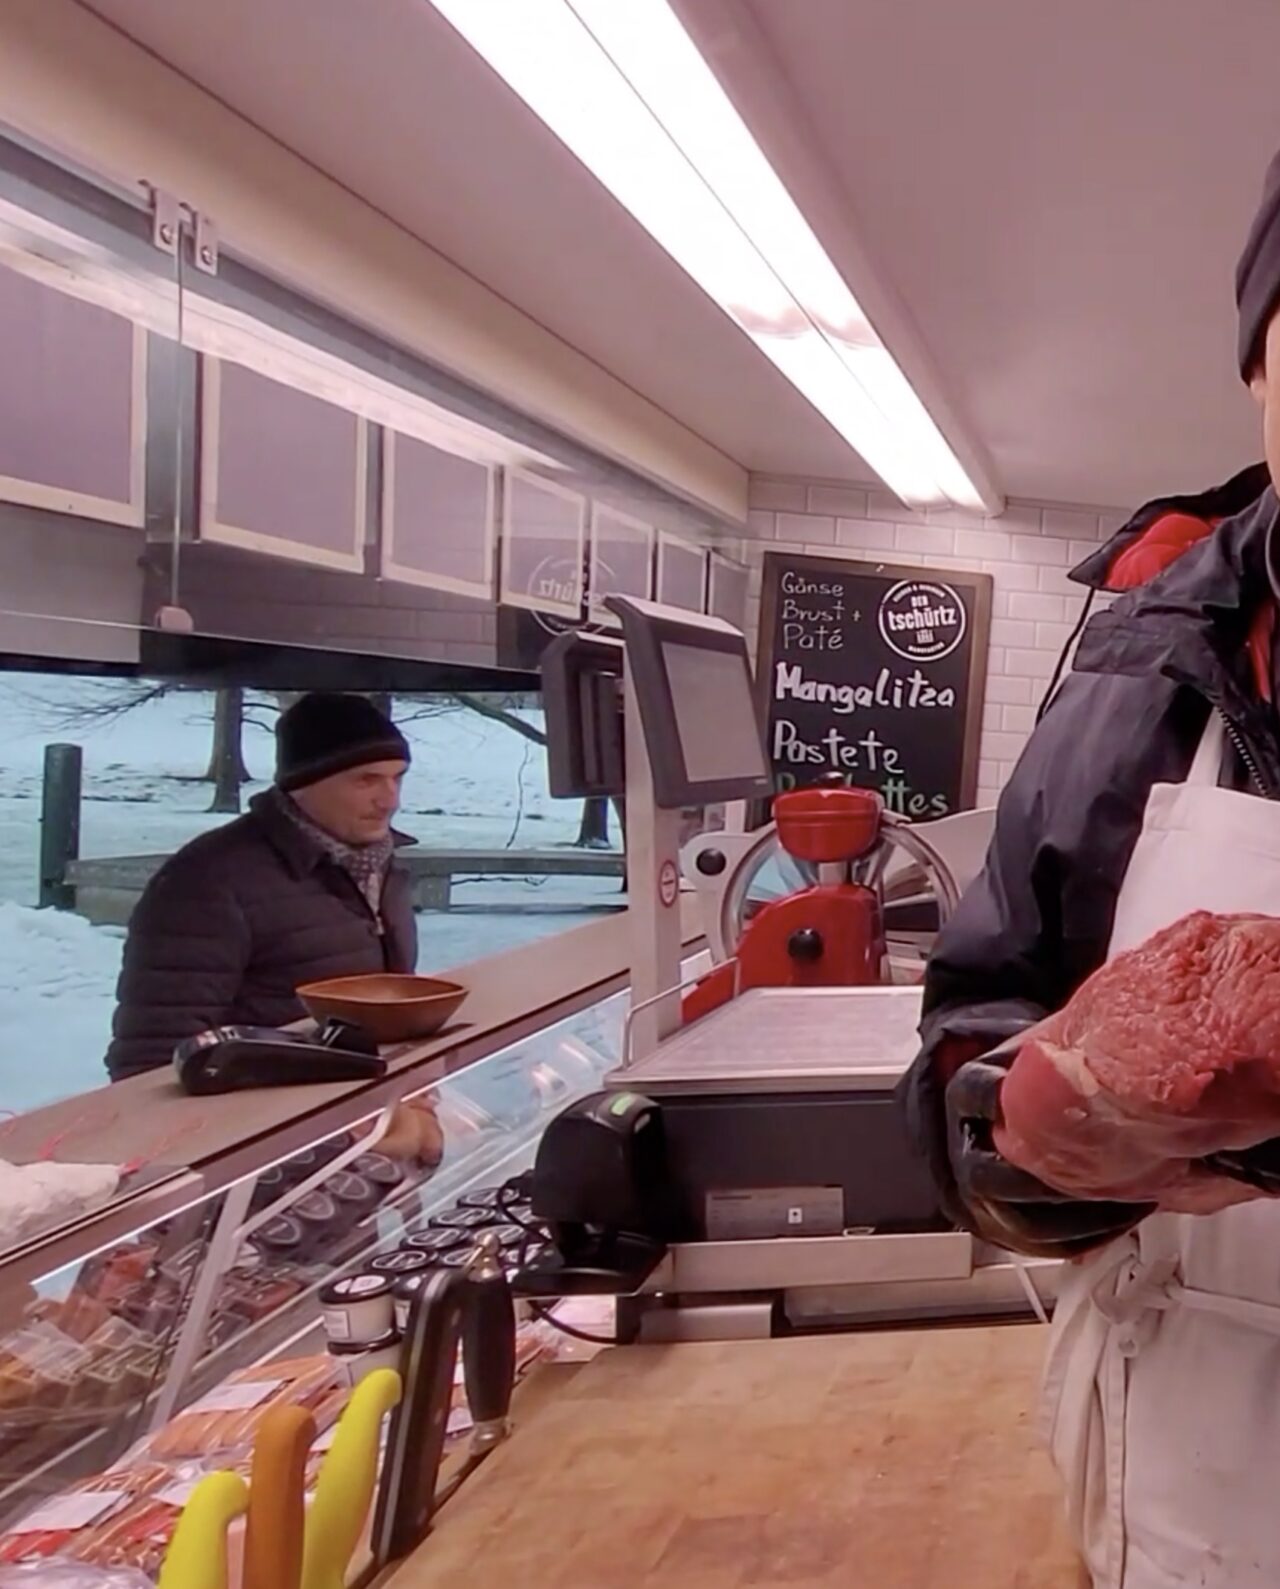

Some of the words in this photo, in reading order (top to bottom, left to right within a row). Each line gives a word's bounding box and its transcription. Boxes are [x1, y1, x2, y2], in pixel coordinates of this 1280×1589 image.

[781, 598, 846, 622] Brust
[852, 609, 862, 622] +
[887, 604, 957, 632] tschürtz
[783, 622, 844, 651] Paté
[775, 661, 956, 714] Mangalitza
[773, 719, 905, 775] Pastete
